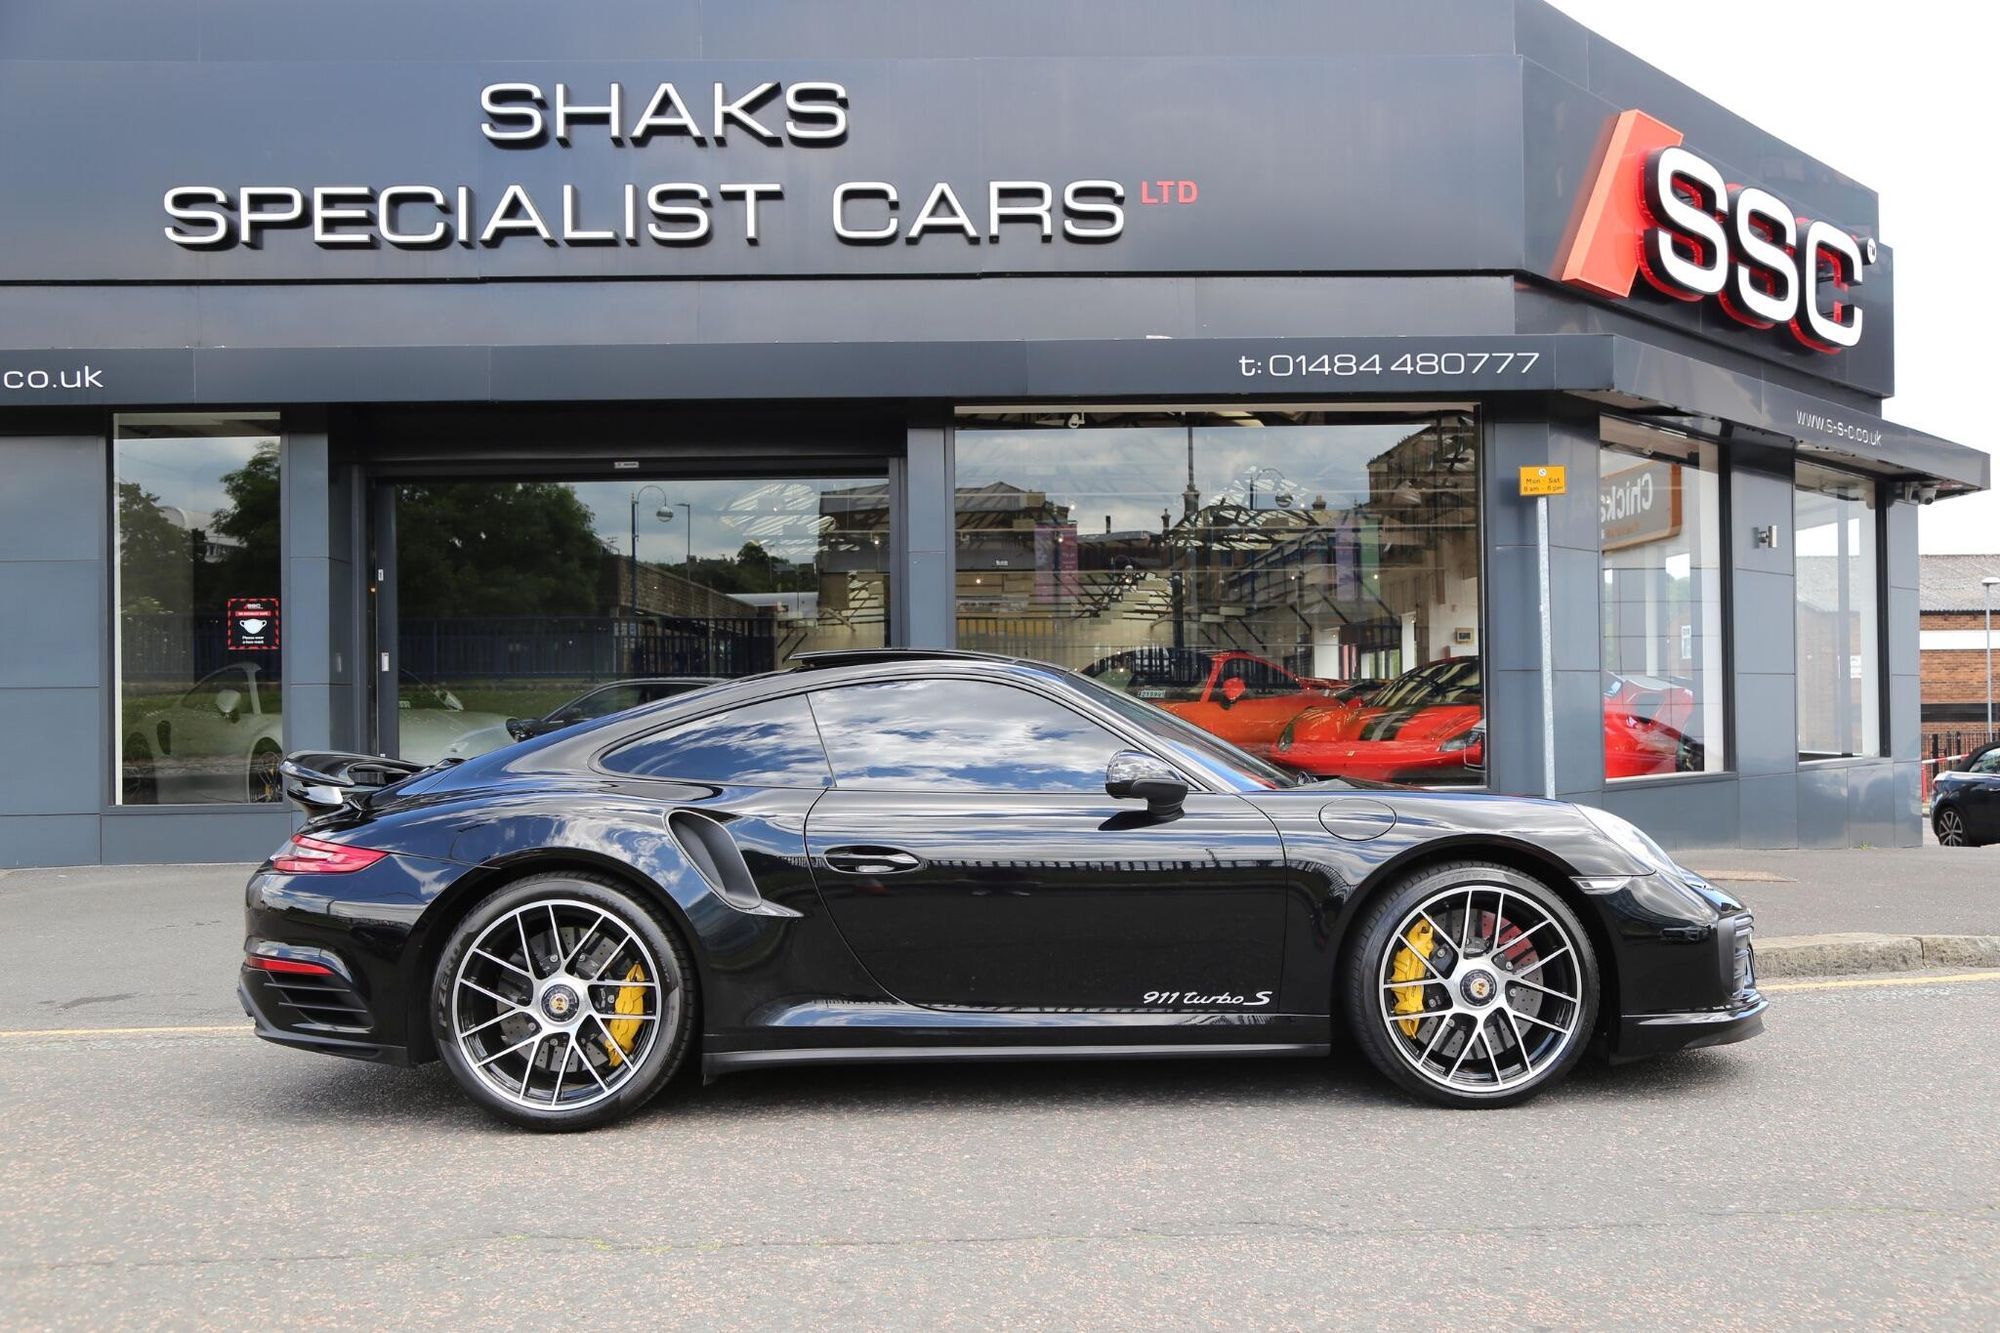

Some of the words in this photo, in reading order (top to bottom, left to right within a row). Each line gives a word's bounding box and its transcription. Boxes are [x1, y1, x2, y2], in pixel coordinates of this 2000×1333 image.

[480, 81, 848, 143] SHAKS
[163, 181, 783, 246] SPECIALIST
[832, 179, 1126, 241] CARS
[1141, 180, 1199, 204] LTD
[1656, 145, 1864, 348] SSC
[3, 365, 104, 389] co.uk
[1238, 355, 1263, 377] t:
[1269, 353, 1383, 377] 01484
[1390, 352, 1541, 375] 480777
[1796, 409, 1883, 447] www.s-s-c.co.uk
[1143, 991, 1180, 1004] 911
[1183, 991, 1245, 1004] turbo
[1242, 991, 1273, 1006] S
